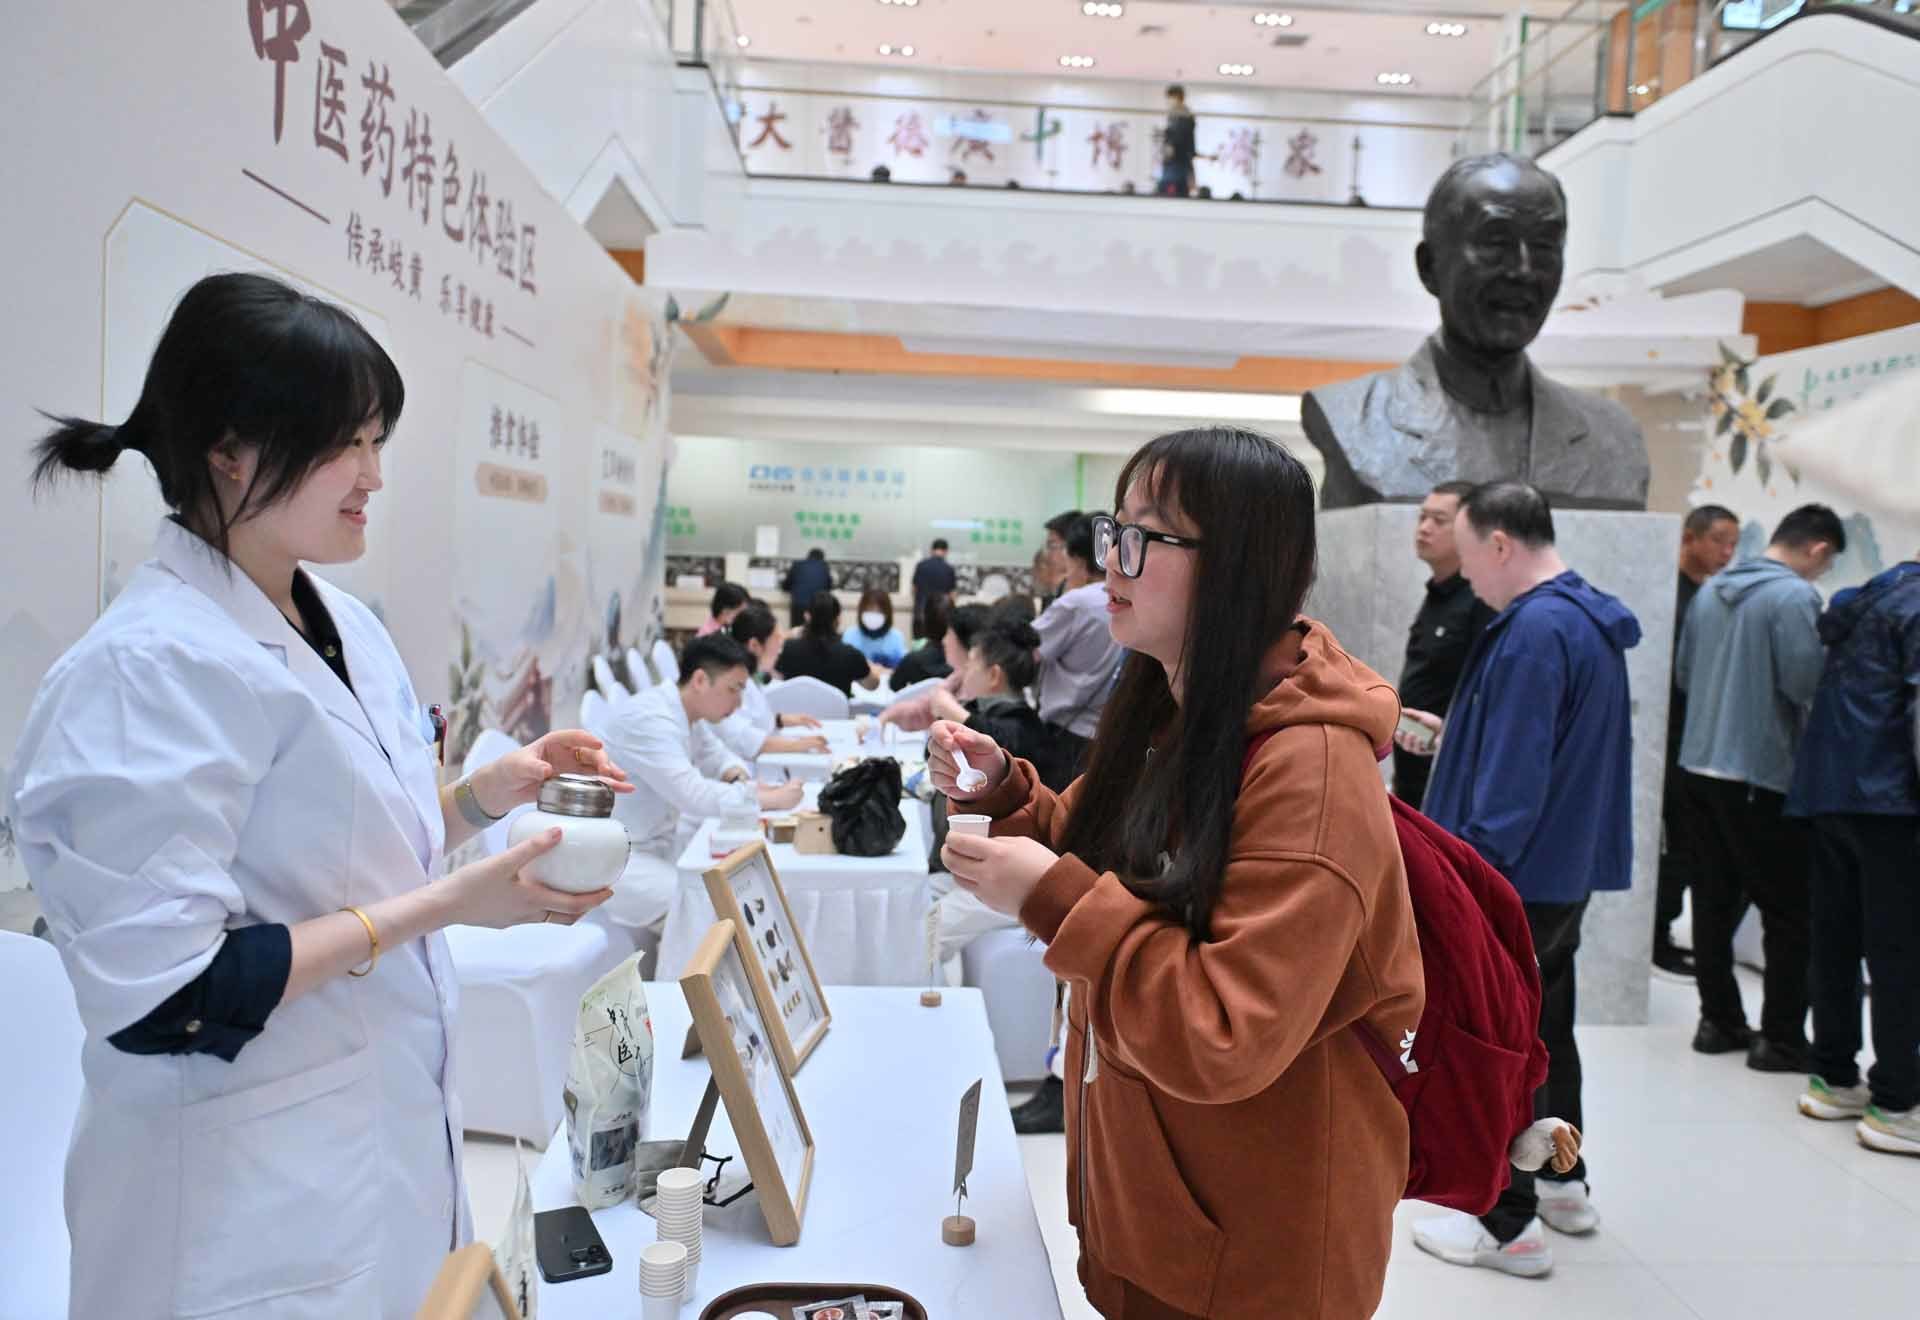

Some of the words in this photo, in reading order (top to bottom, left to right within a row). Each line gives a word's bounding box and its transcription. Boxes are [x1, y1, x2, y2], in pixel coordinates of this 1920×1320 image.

[247, 0, 537, 294] 中医药特色体验区
